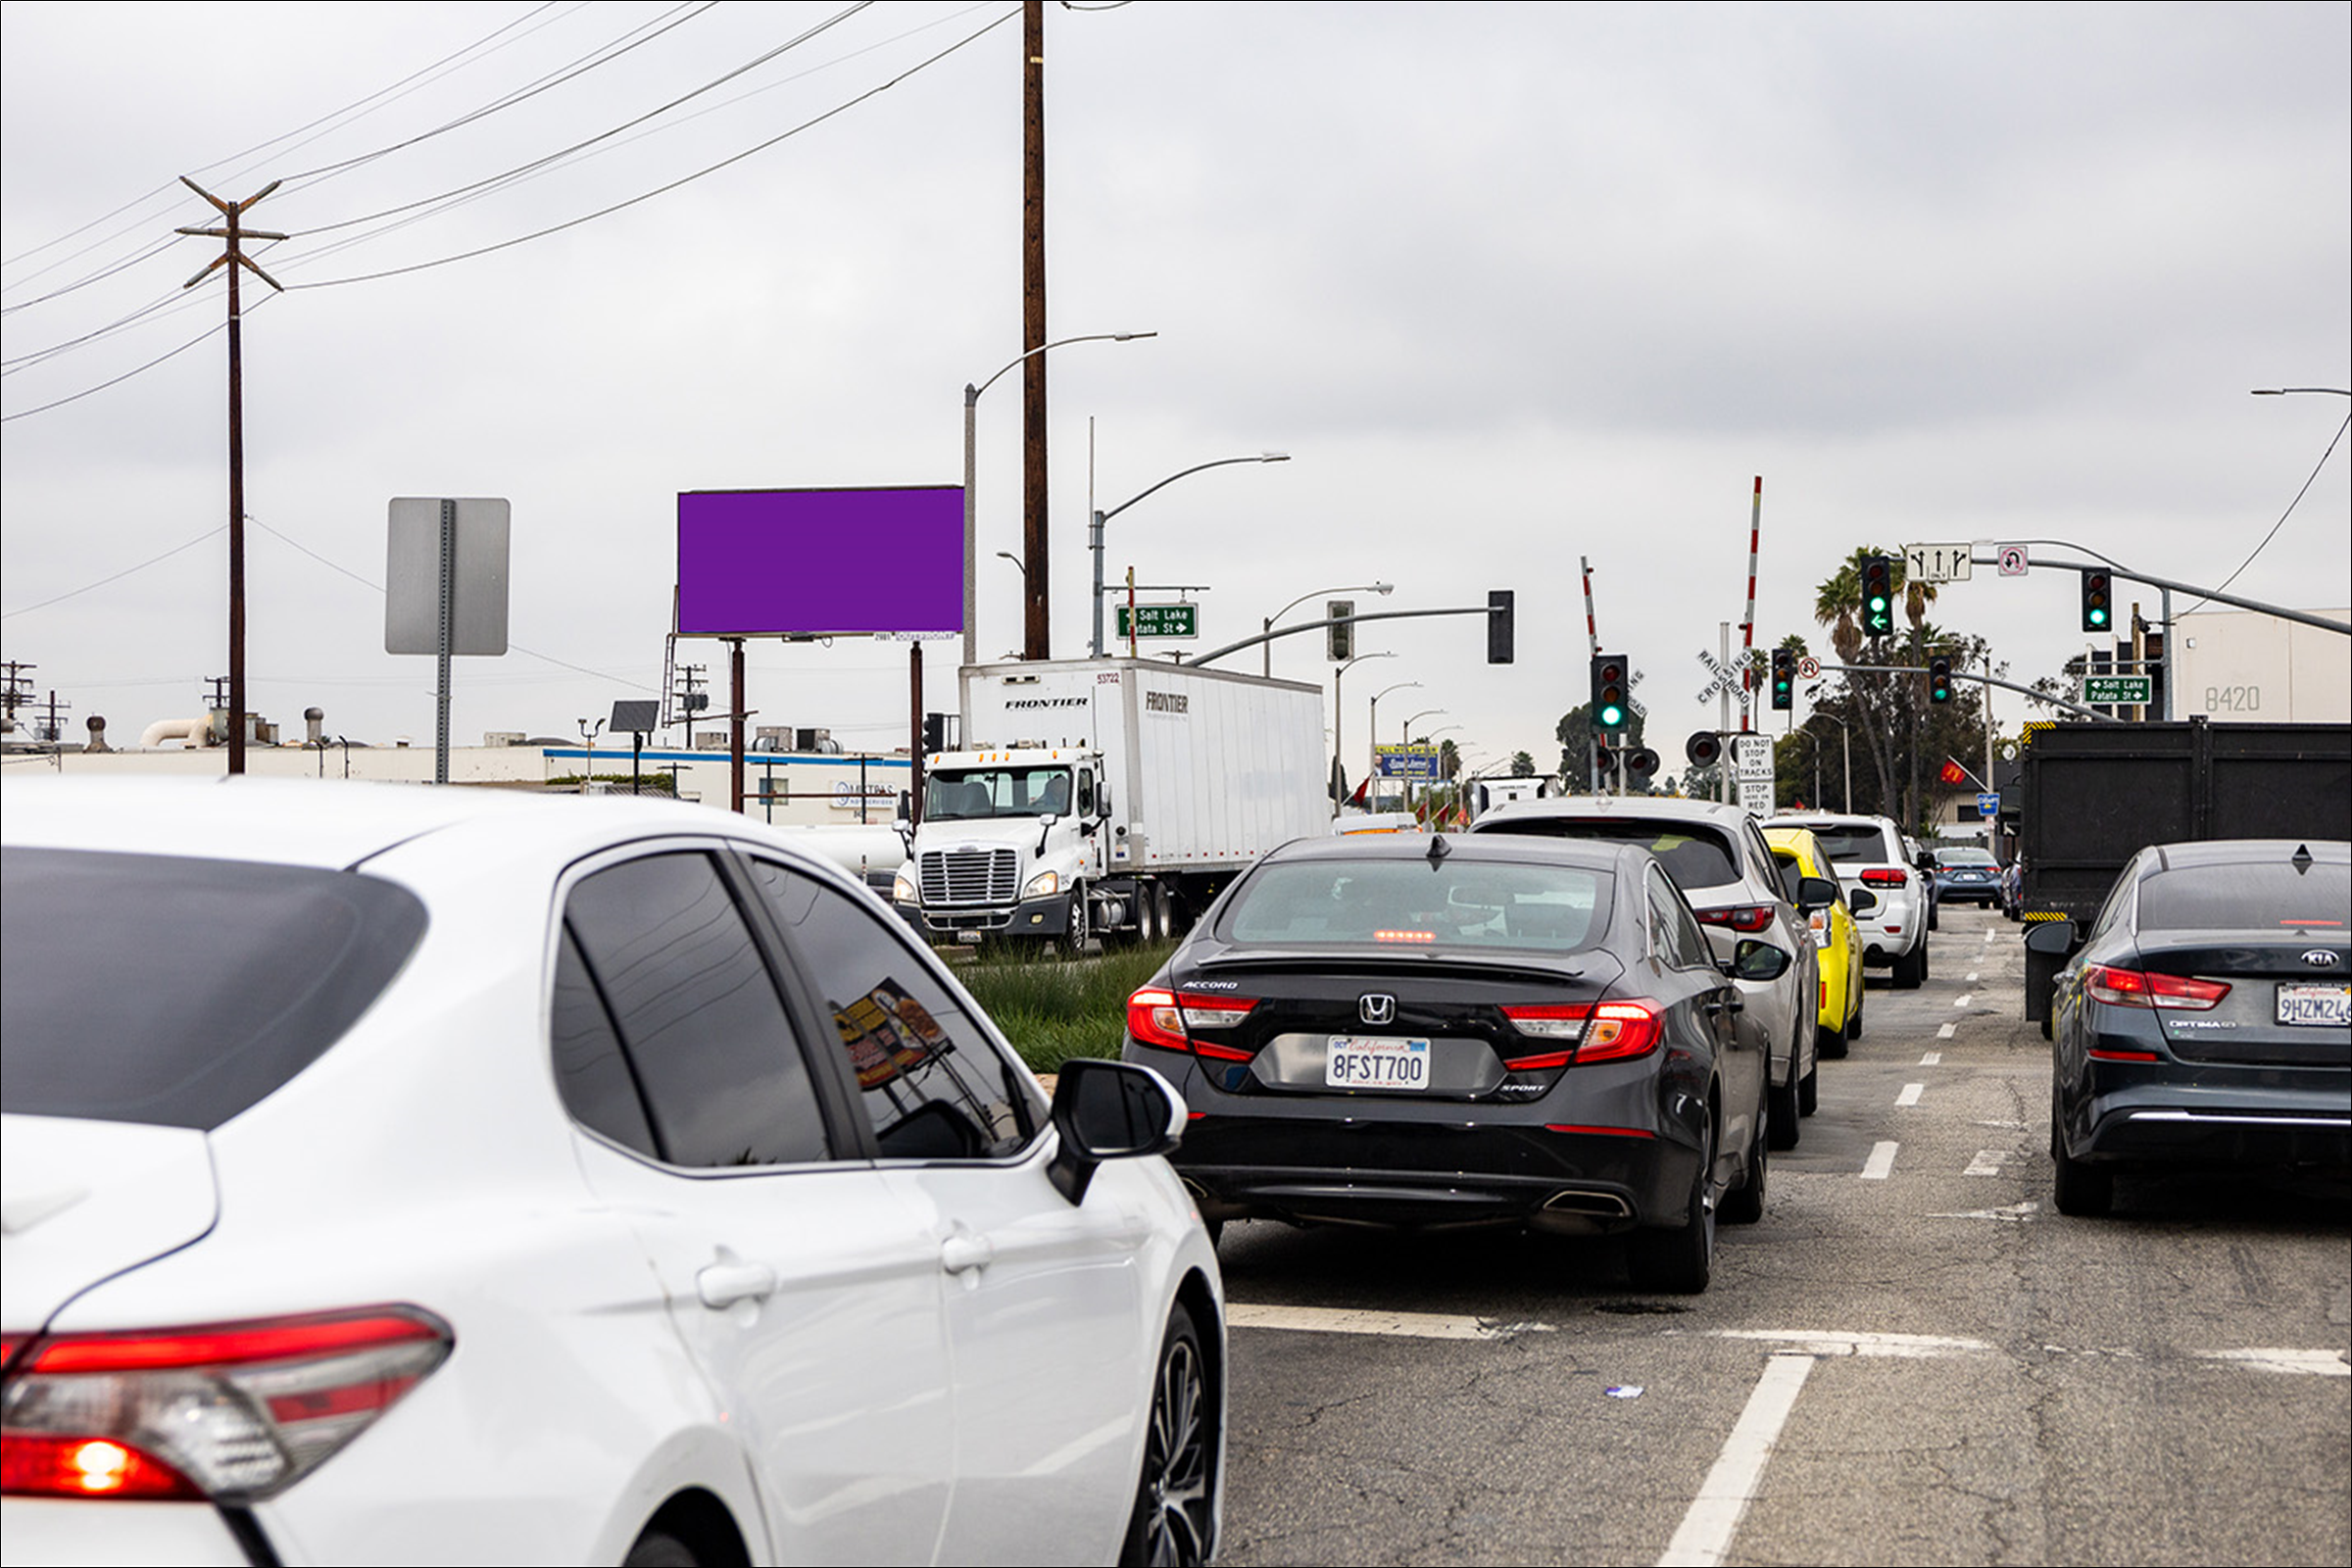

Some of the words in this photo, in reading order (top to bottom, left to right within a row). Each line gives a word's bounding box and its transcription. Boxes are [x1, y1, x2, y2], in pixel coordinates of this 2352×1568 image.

[1140, 610, 1158, 621] Salt
[1163, 610, 1188, 620] Lake
[1126, 623, 1156, 634] Ptata
[1162, 622, 1174, 634] St
[1097, 672, 1120, 684] 53722
[2102, 680, 2120, 689] Salt
[2124, 680, 2144, 690] Lake
[2090, 691, 2118, 701] Patata
[2123, 691, 2132, 700] St
[2205, 686, 2261, 711] 8420
[1004, 697, 1089, 710] FRONTIER
[1146, 691, 1189, 714] FRONTIER
[1744, 749, 1766, 758] STOP
[1740, 768, 1772, 777] TRACKS
[1745, 785, 1768, 794] STOP
[2308, 953, 2332, 965] KIA
[1182, 981, 1239, 990] ACCORD
[2293, 986, 2345, 998] California
[2169, 1020, 2221, 1029] OPTIMA
[1348, 1039, 1410, 1055] California
[1333, 1054, 1423, 1081] 8FST700
